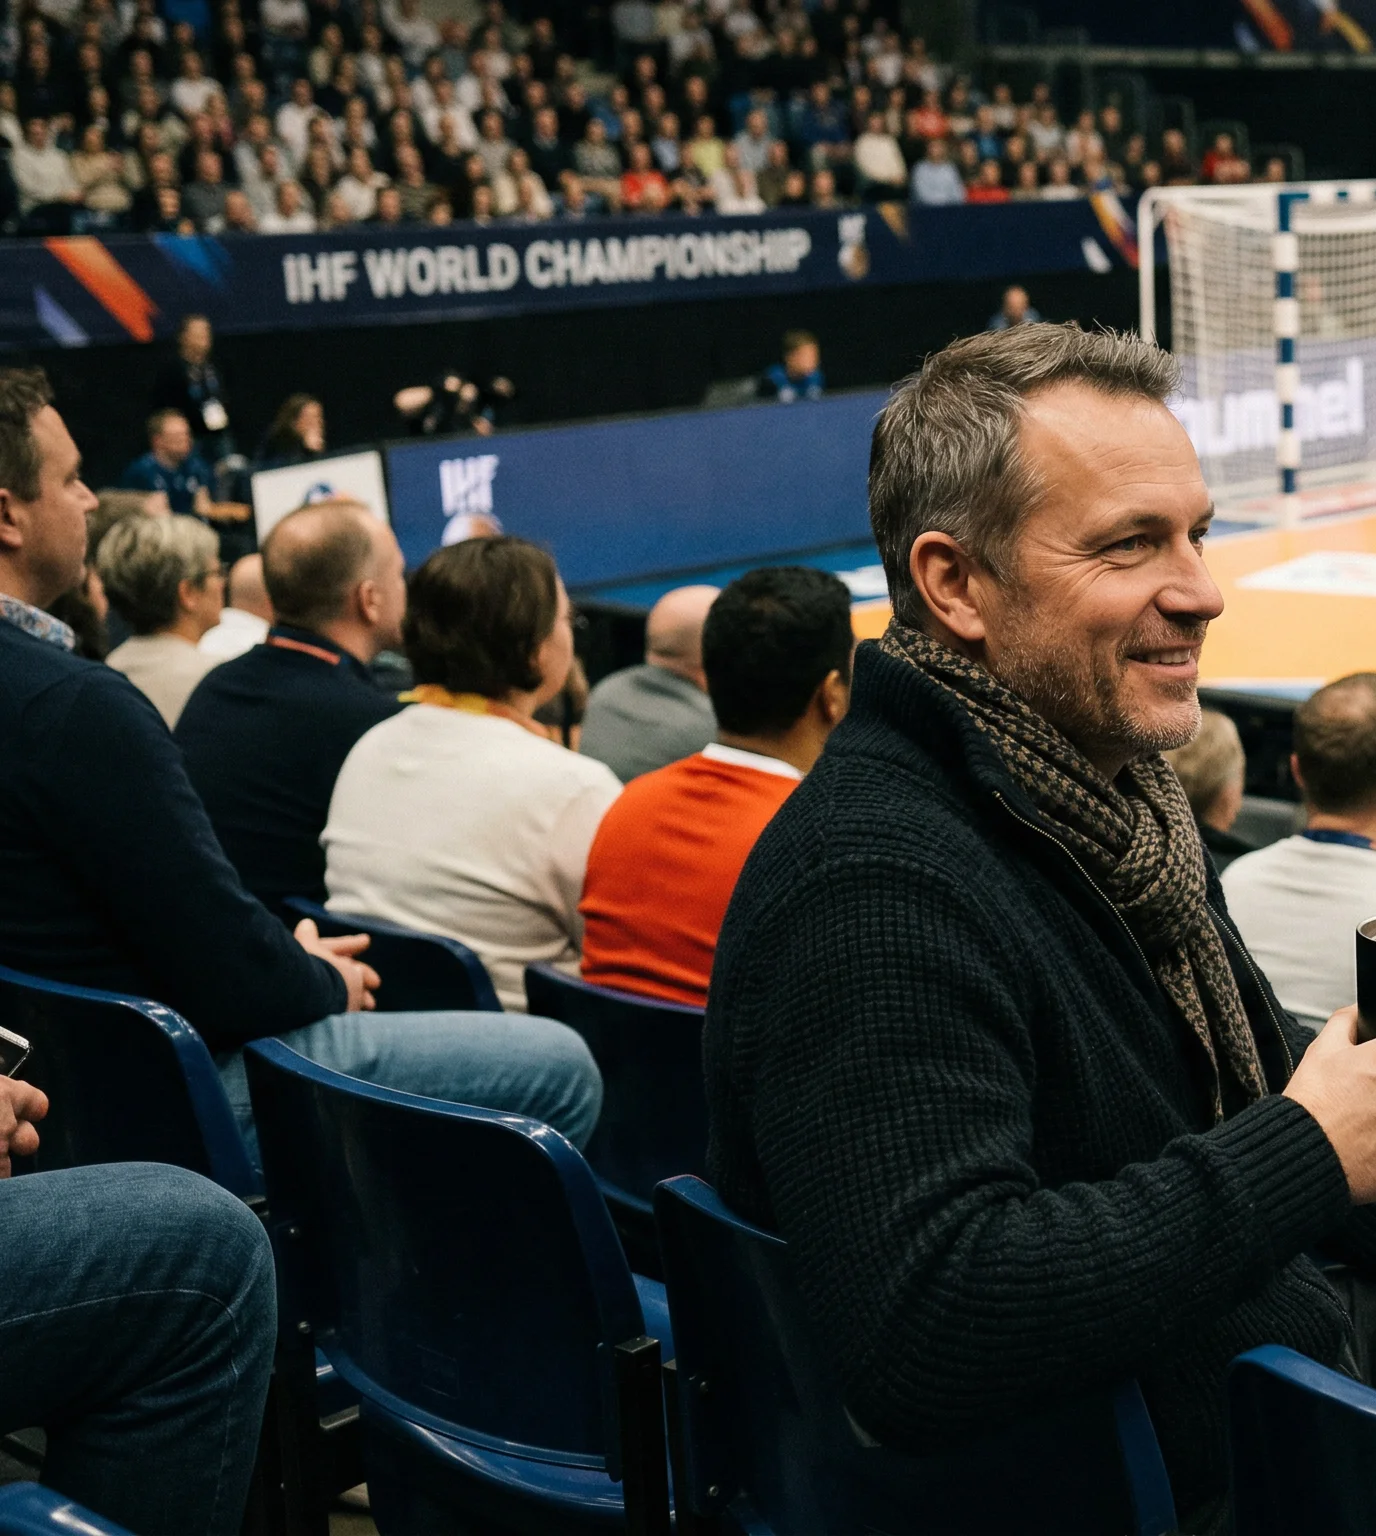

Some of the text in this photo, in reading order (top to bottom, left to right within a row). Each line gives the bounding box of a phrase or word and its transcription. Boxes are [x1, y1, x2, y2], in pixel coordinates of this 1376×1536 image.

[283, 228, 812, 302] IHF WORLD CHAMPIONSHIP
